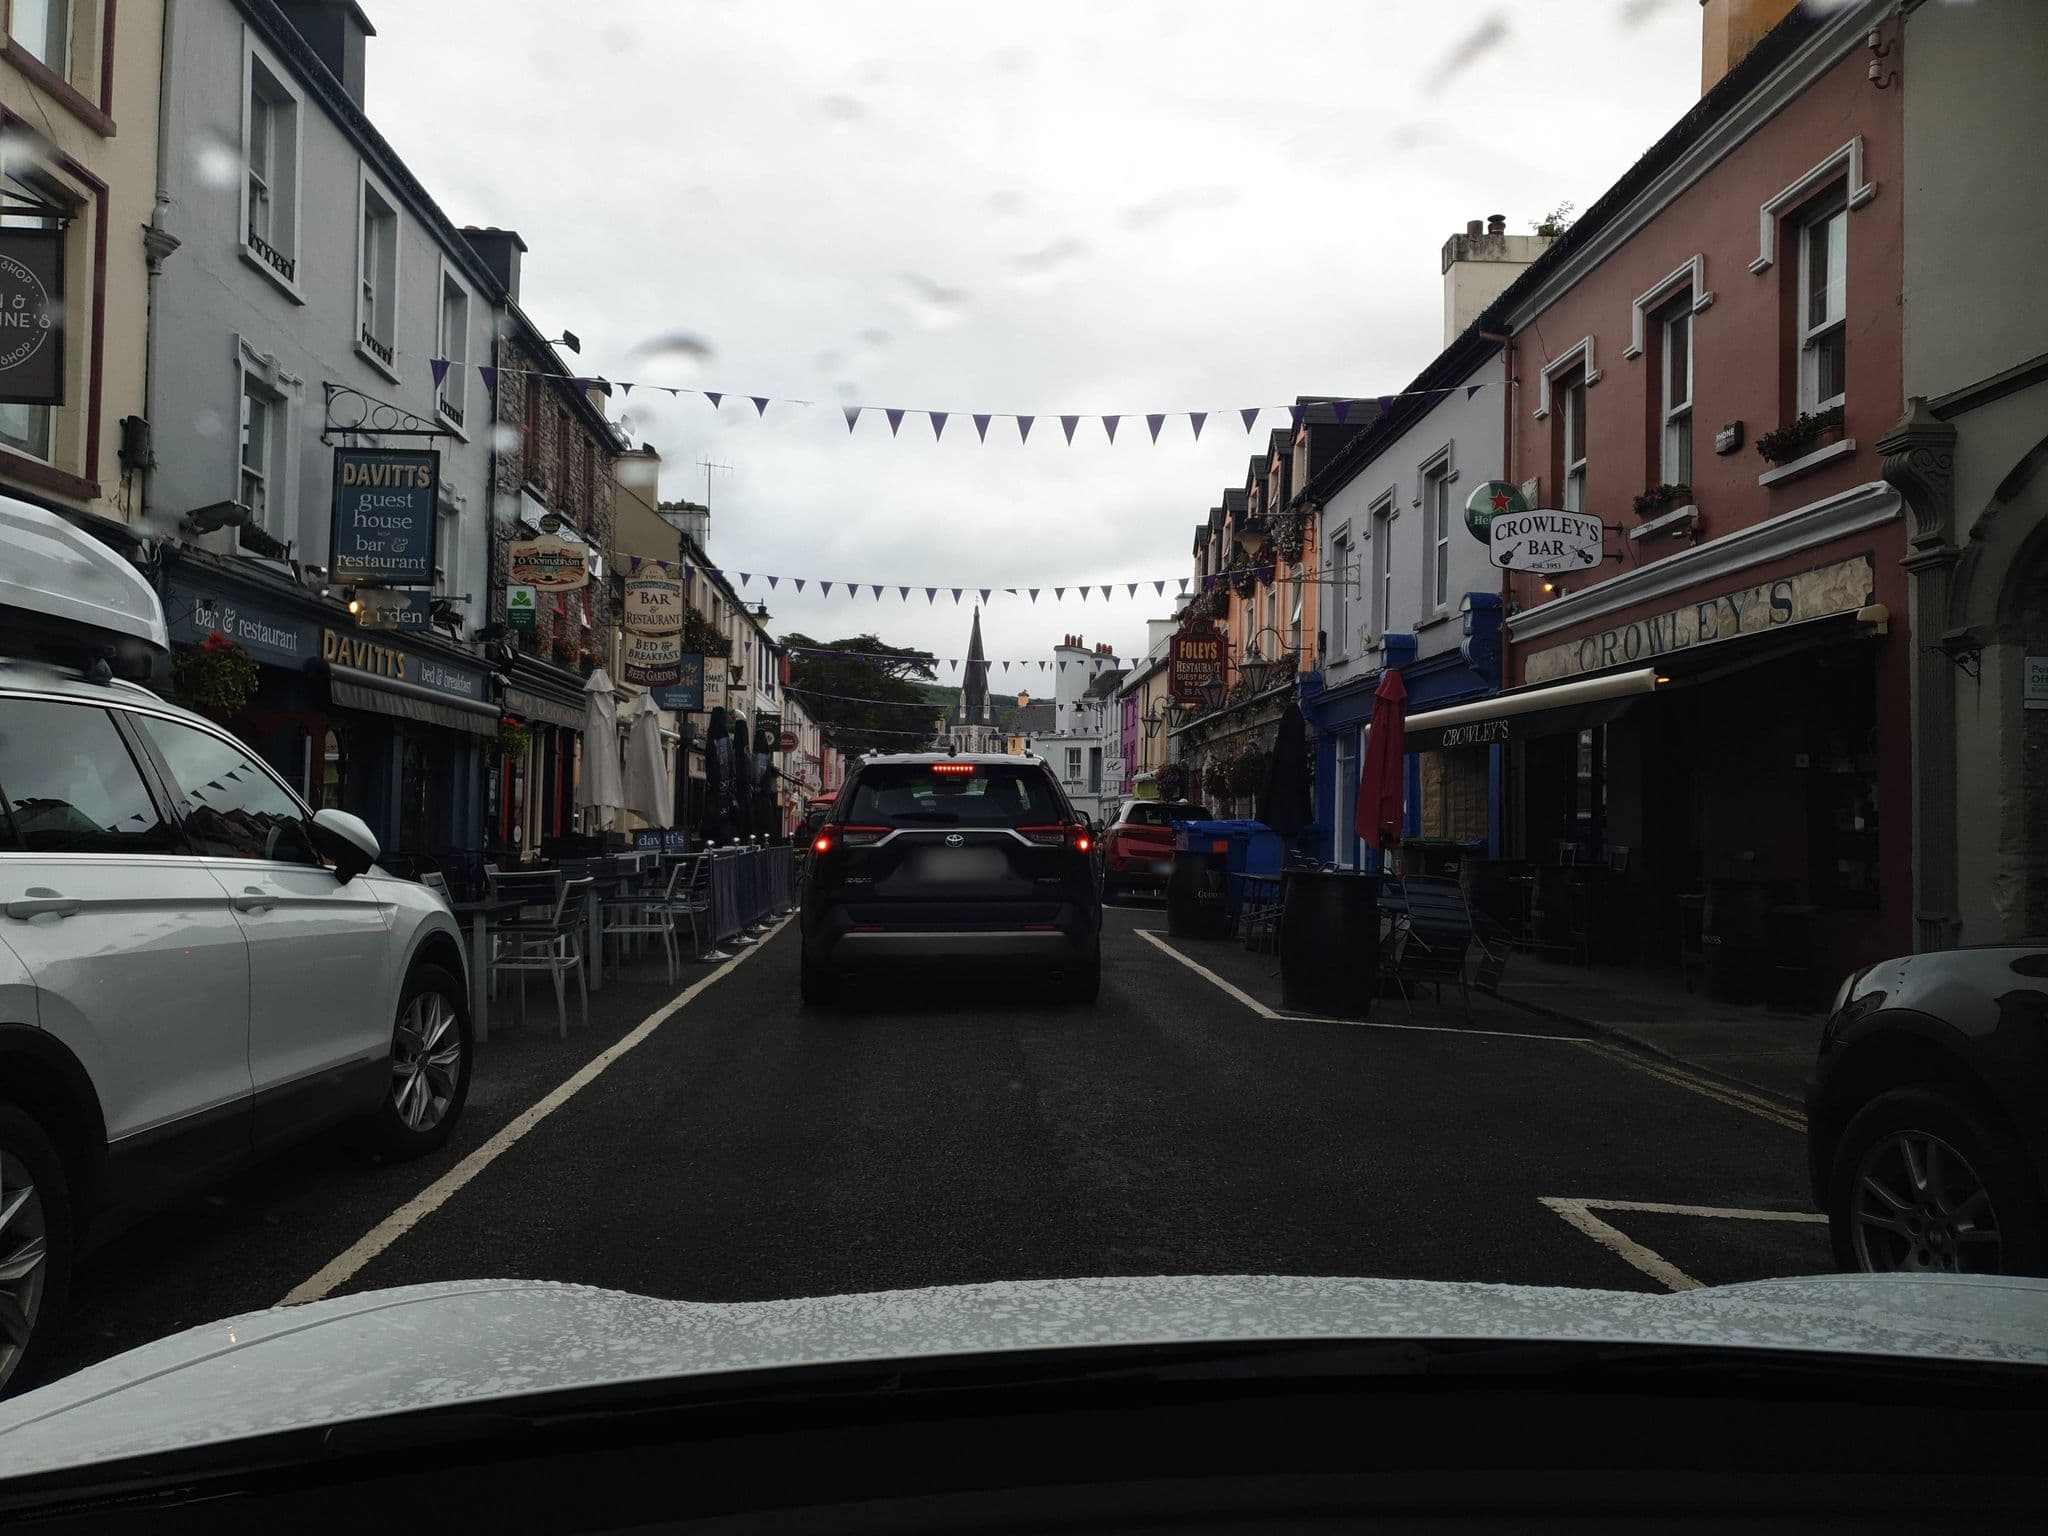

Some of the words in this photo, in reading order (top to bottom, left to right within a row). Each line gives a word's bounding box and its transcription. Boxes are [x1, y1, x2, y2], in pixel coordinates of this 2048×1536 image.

[1, 260, 32, 284] SHOP
[12, 294, 26, 309] &
[1, 342, 31, 366] SHOP
[359, 493, 414, 512] guest
[353, 509, 413, 529] house
[1495, 515, 1599, 542] CROWLEY'S
[356, 534, 385, 551] bar
[392, 538, 408, 553] &
[1528, 540, 1565, 556] BAR
[337, 554, 426, 569] restaurant
[640, 591, 671, 606] BAR
[195, 599, 219, 629] bar
[222, 607, 236, 634] &
[238, 618, 298, 651] restaurant
[626, 611, 681, 626] RESTAURANT
[1578, 578, 1795, 673] CROWLEY'S
[635, 639, 658, 651] BED
[661, 641, 673, 651] &
[628, 650, 679, 661] BREAKFAST
[1176, 660, 1221, 673] RESTAURANT
[2032, 664, 2048, 673] Po
[421, 662, 435, 683] bed
[443, 670, 472, 694] breakfast
[646, 669, 678, 682] GARDEN
[1442, 719, 1509, 747] CROWLEY'S
[638, 832, 684, 846] davtt's
